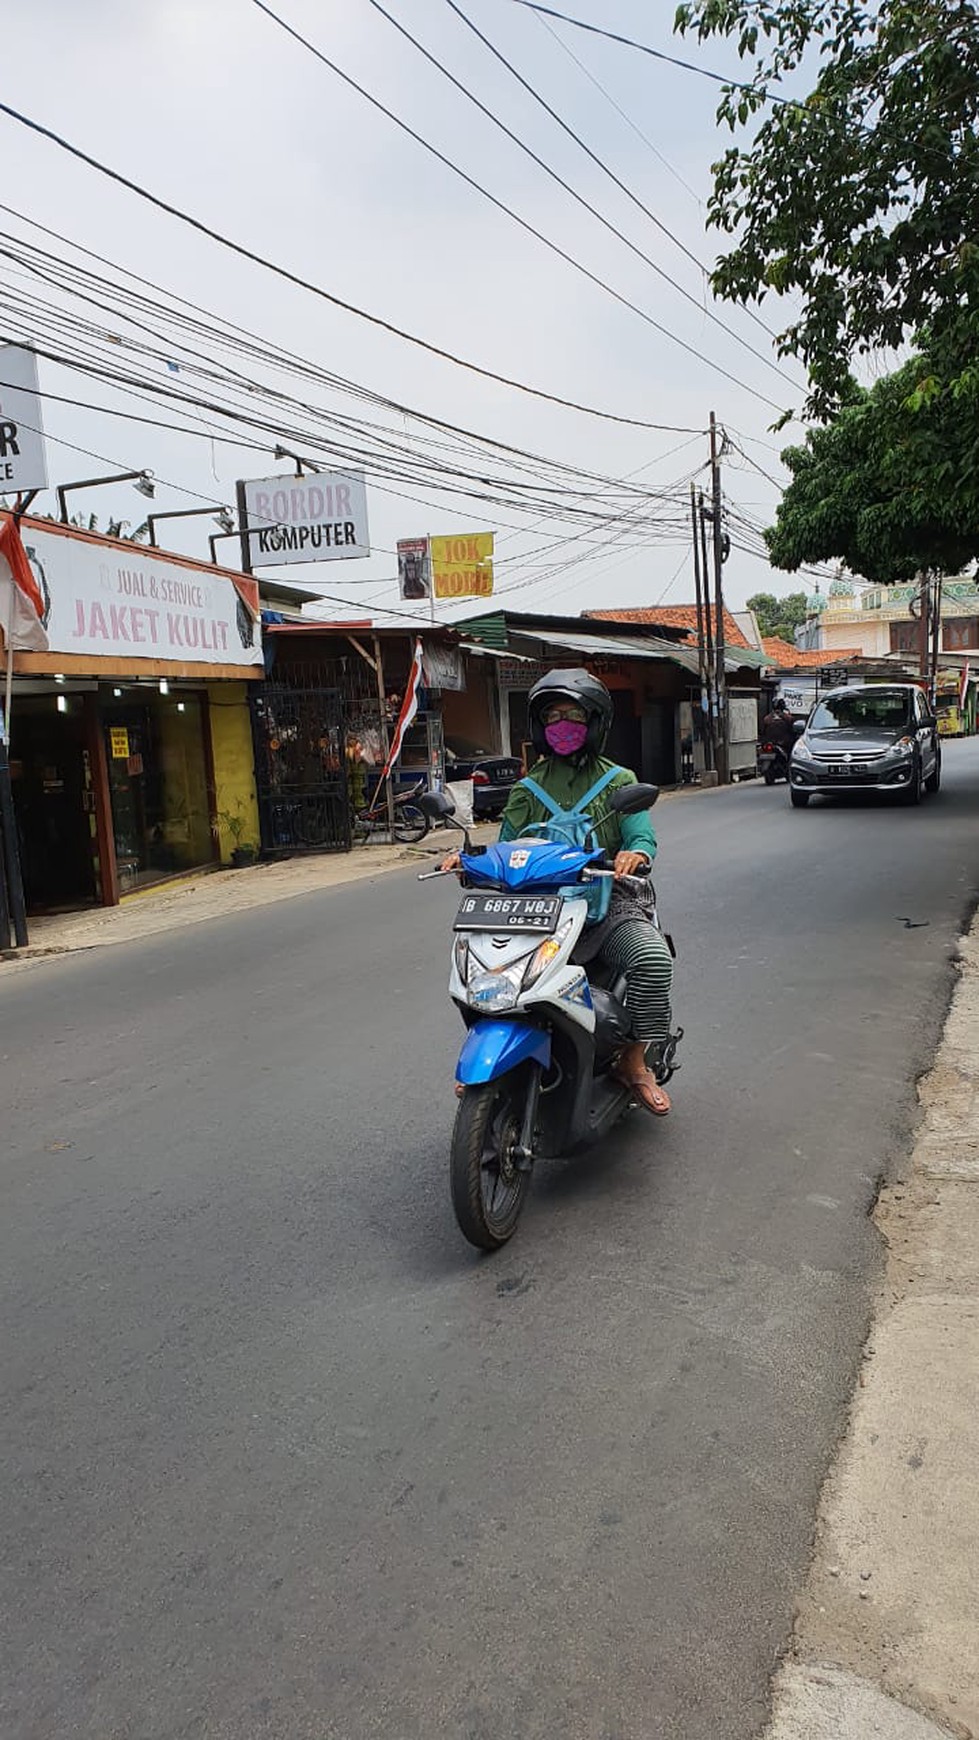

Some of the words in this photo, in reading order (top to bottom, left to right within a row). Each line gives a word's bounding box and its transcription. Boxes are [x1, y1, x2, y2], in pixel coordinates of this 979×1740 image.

[255, 483, 352, 524] BORDIR
[259, 521, 357, 553] KOMPUTER
[117, 568, 147, 597] JUAL
[150, 577, 159, 600] &
[161, 578, 203, 608] SERVICE
[72, 598, 160, 644] JAKET
[166, 611, 229, 650] KULIT
[466, 899, 476, 912] B
[484, 899, 521, 912] 6867
[509, 916, 550, 926] 06-21
